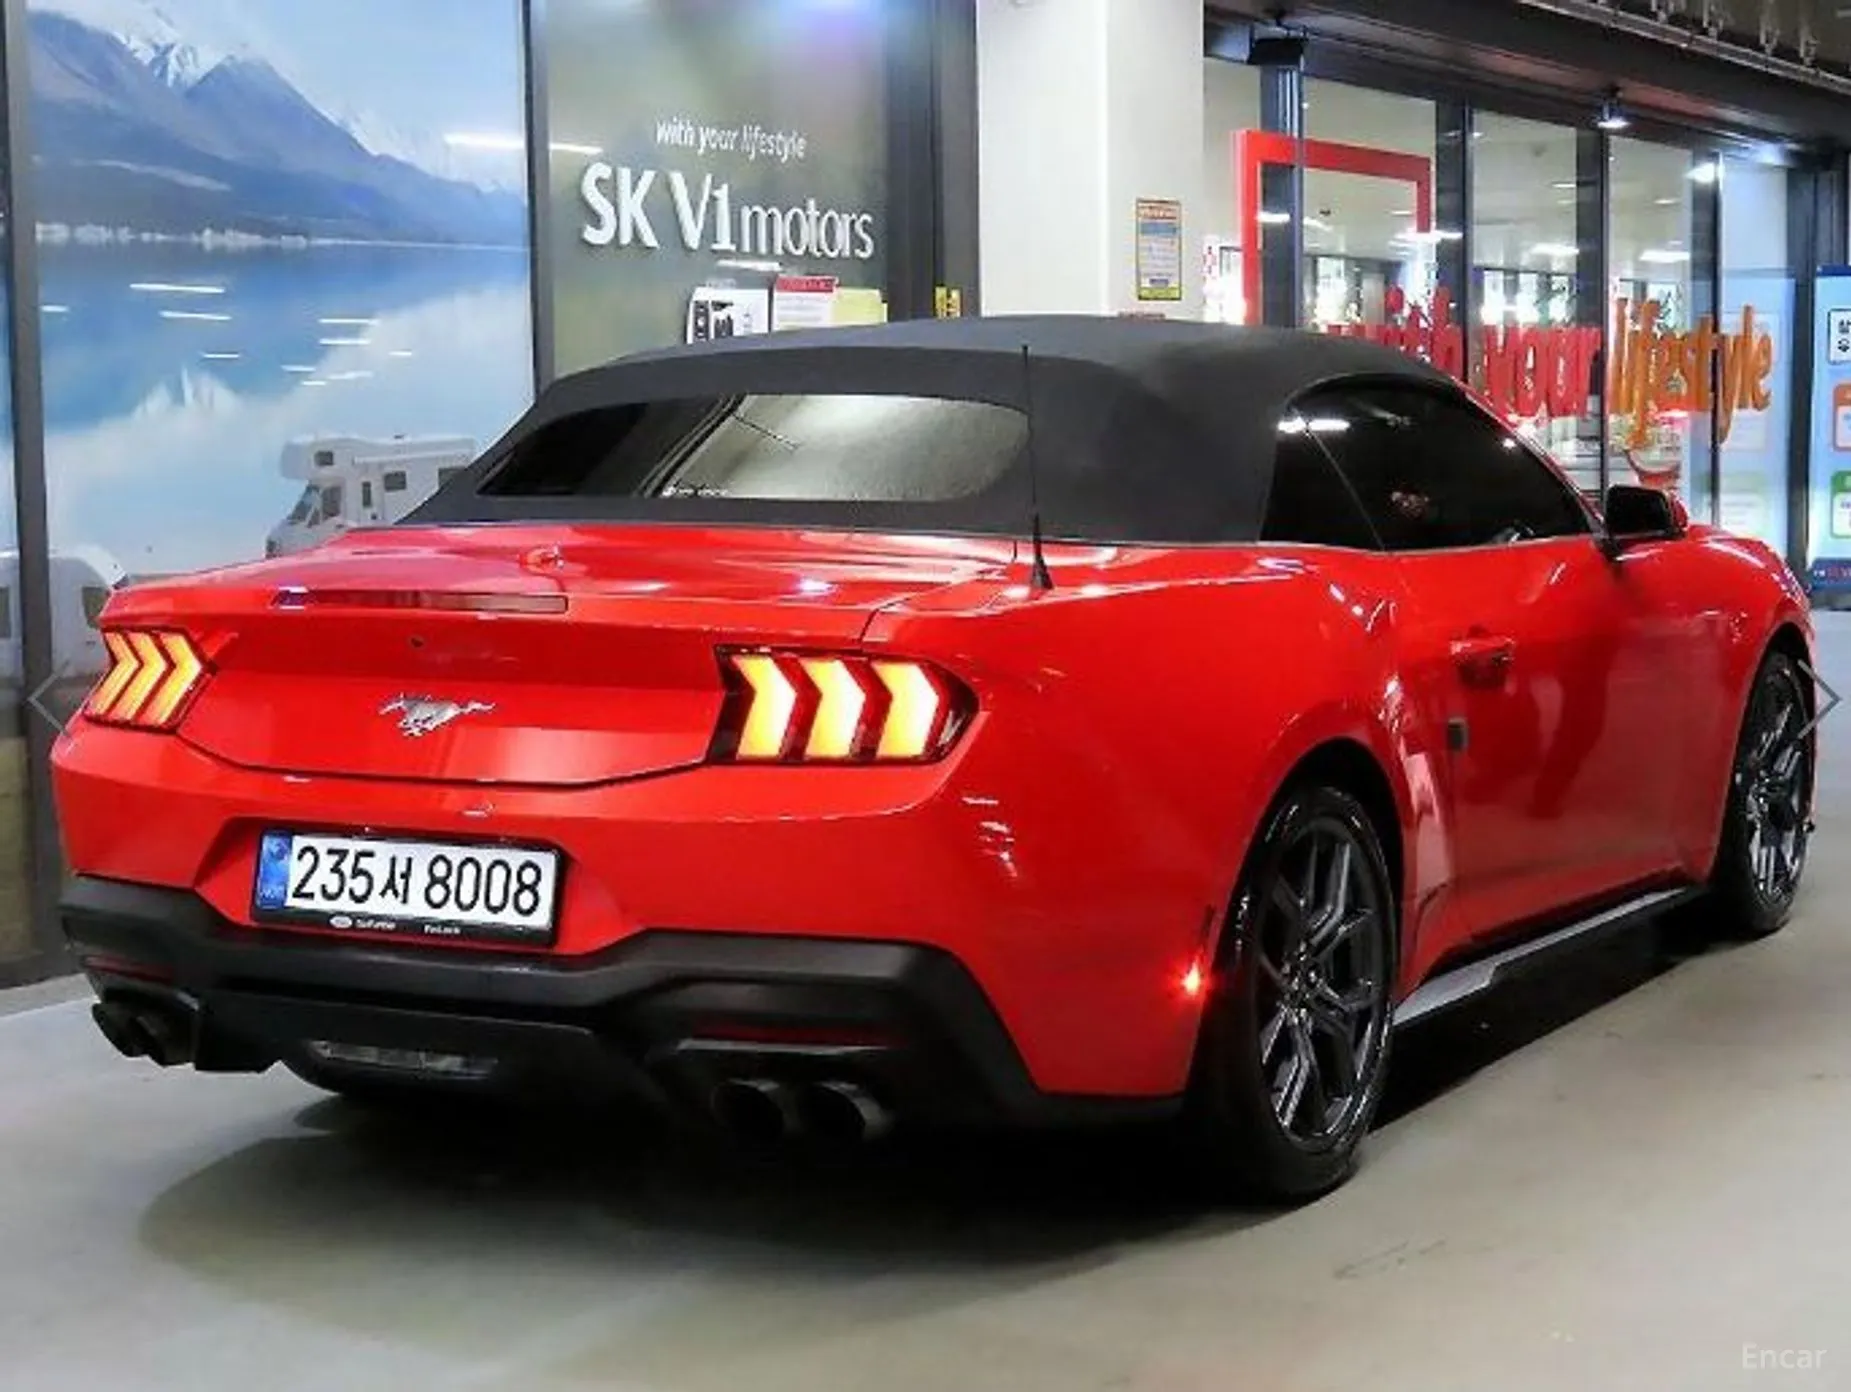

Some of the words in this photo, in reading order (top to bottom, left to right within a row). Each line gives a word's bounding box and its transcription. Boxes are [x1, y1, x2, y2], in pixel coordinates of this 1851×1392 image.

[656, 117, 694, 147] with
[698, 126, 737, 155] your
[742, 125, 808, 162] lifestyle
[580, 161, 660, 250] SK
[1608, 296, 1774, 450] lifestyle
[291, 846, 413, 905] 235서
[424, 854, 543, 917] 8008
